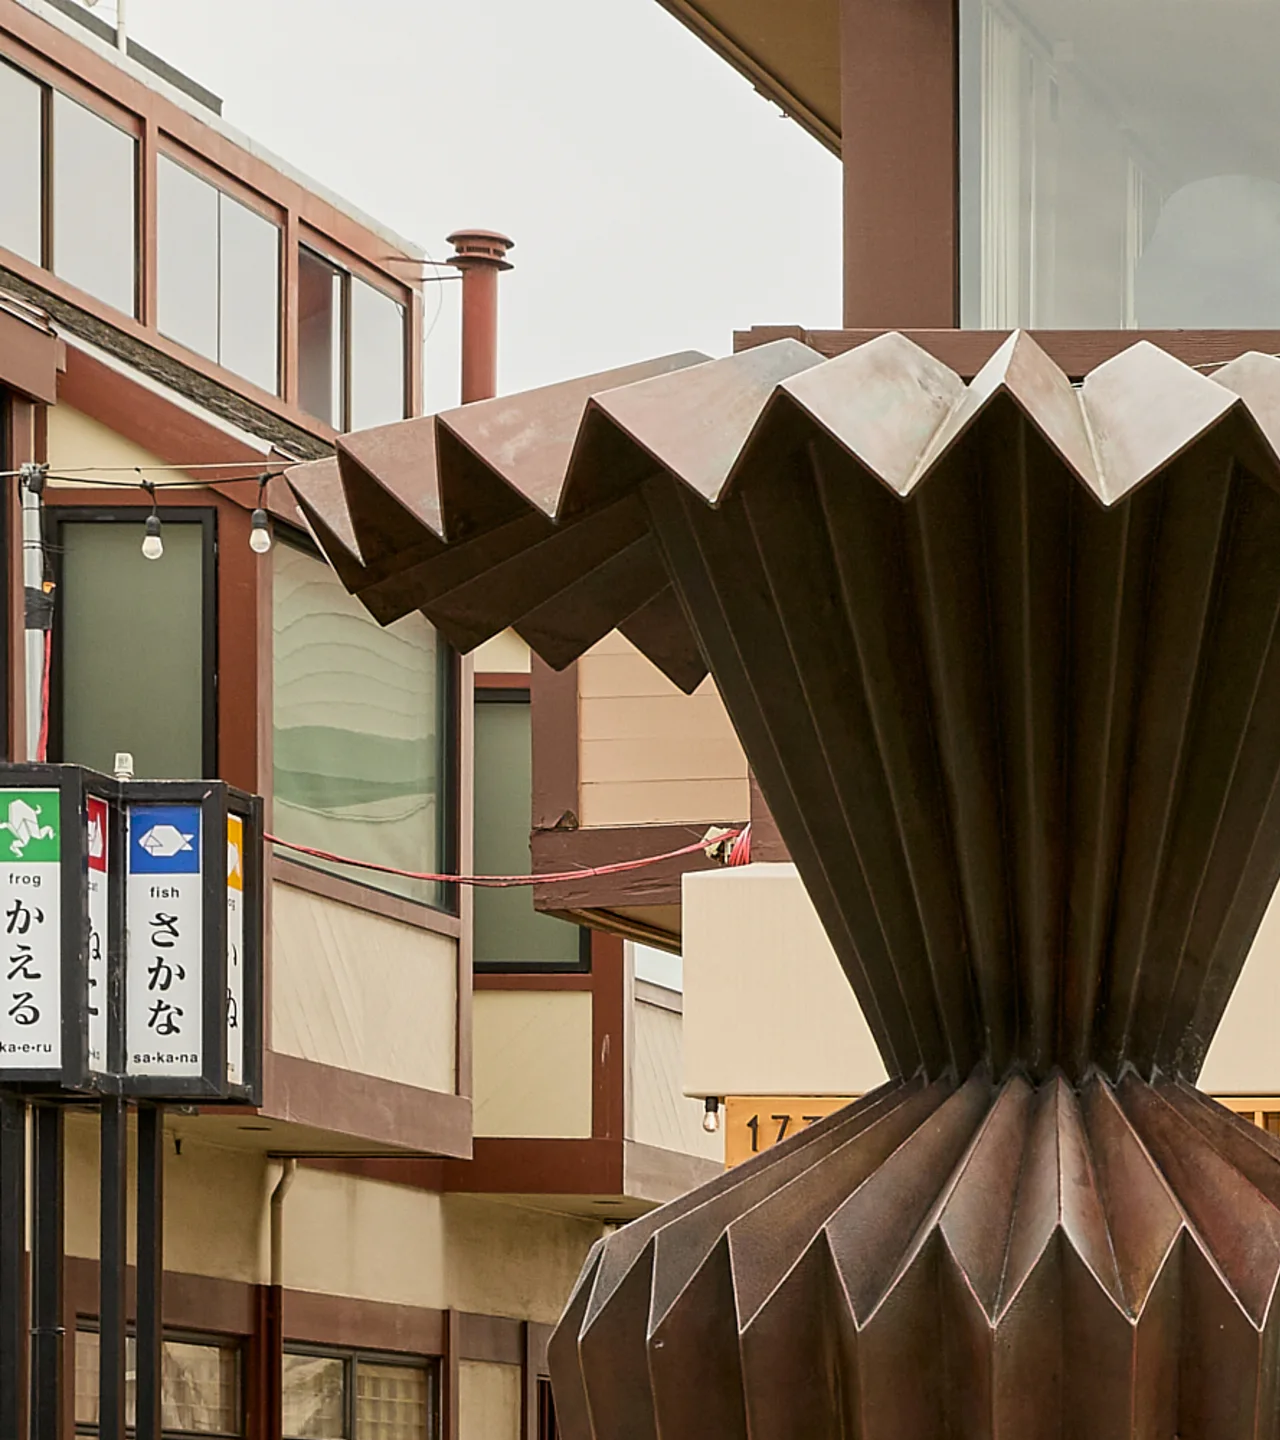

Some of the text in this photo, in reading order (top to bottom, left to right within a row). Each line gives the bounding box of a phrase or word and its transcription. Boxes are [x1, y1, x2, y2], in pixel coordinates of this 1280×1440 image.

[9, 873, 41, 888] frog
[150, 886, 180, 899] fish
[6, 899, 45, 1026] かえる
[147, 912, 186, 1036] さかな
